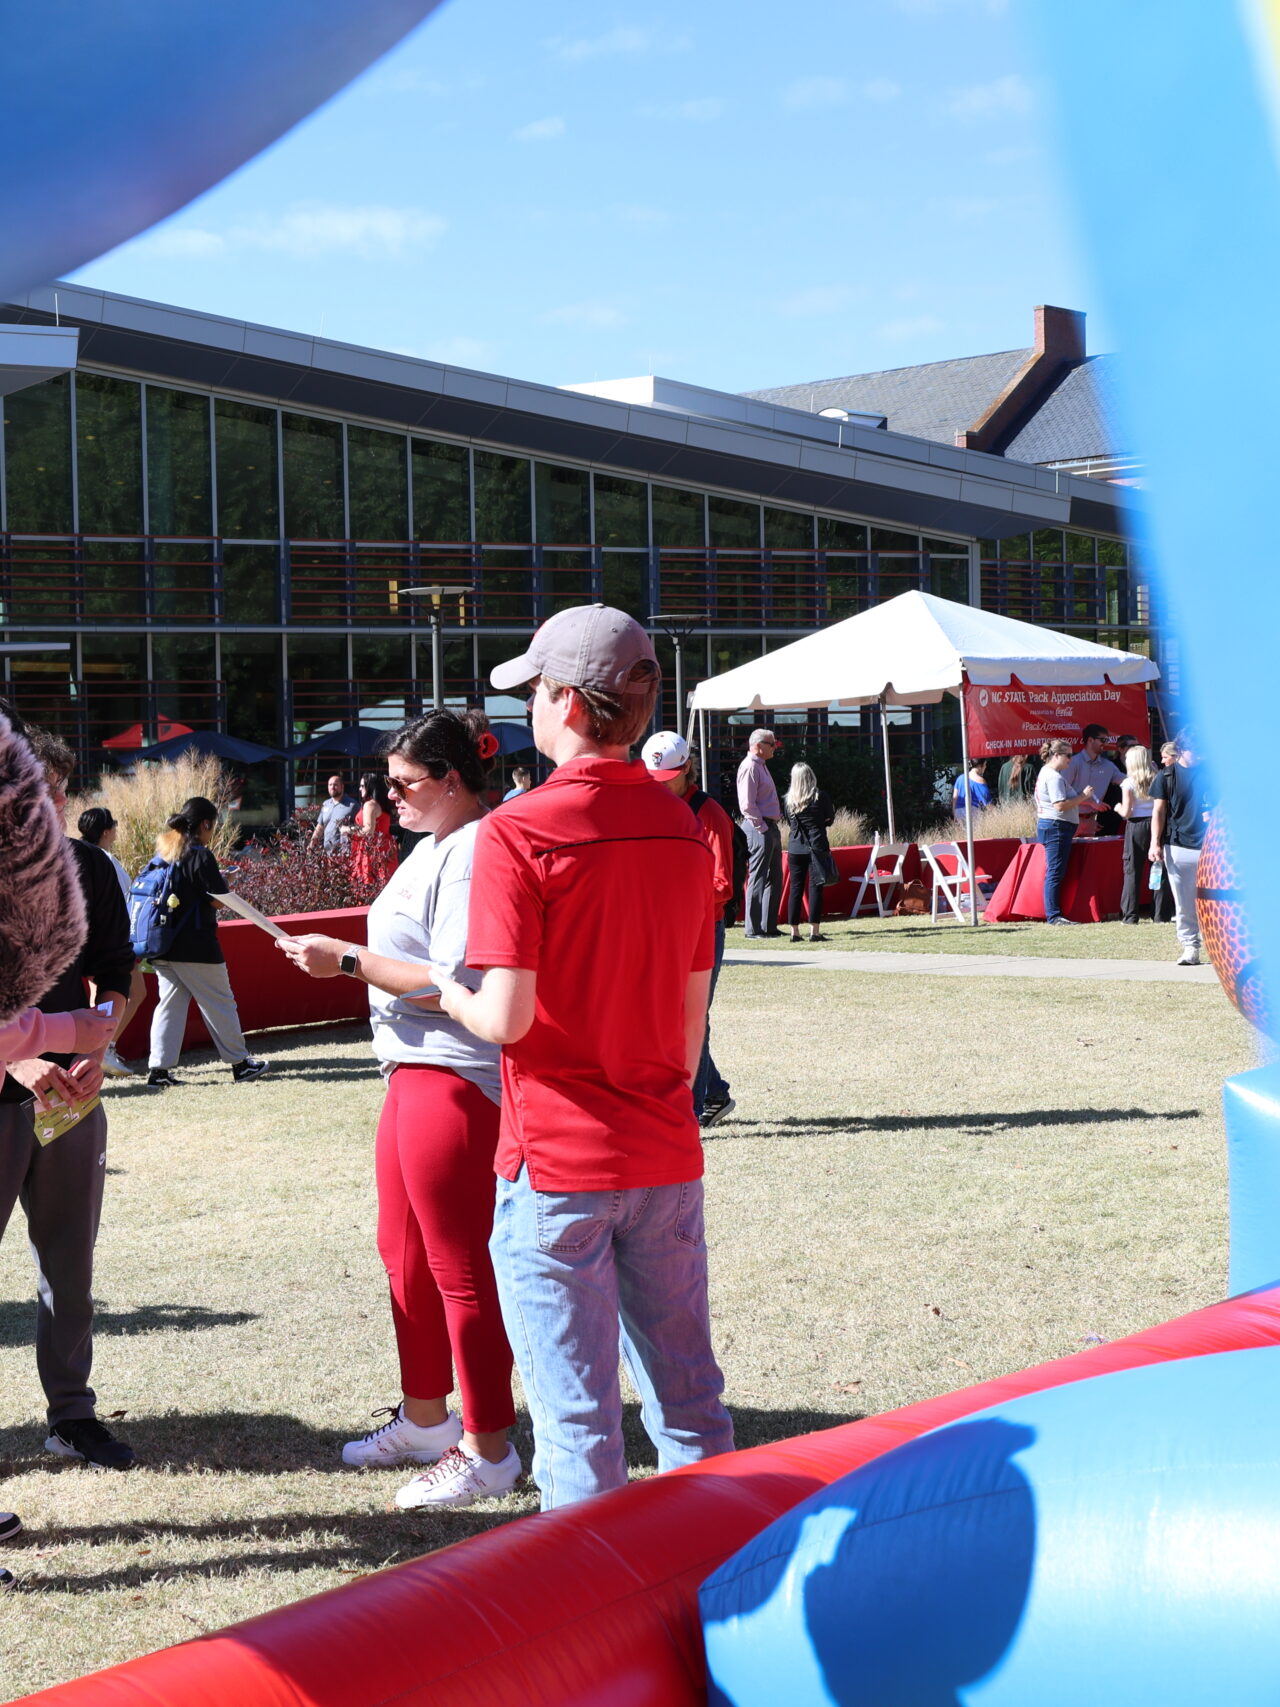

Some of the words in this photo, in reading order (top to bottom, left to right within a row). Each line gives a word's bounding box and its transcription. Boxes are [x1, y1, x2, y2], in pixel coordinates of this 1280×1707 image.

[991, 691, 1003, 703] NC
[1003, 691, 1026, 703] STATE
[1028, 691, 1049, 703] Pack
[1051, 689, 1102, 704] Appreciation
[1104, 689, 1121, 703] Day
[985, 739, 1012, 749] CHECK-IN
[1013, 739, 1028, 748] AND
